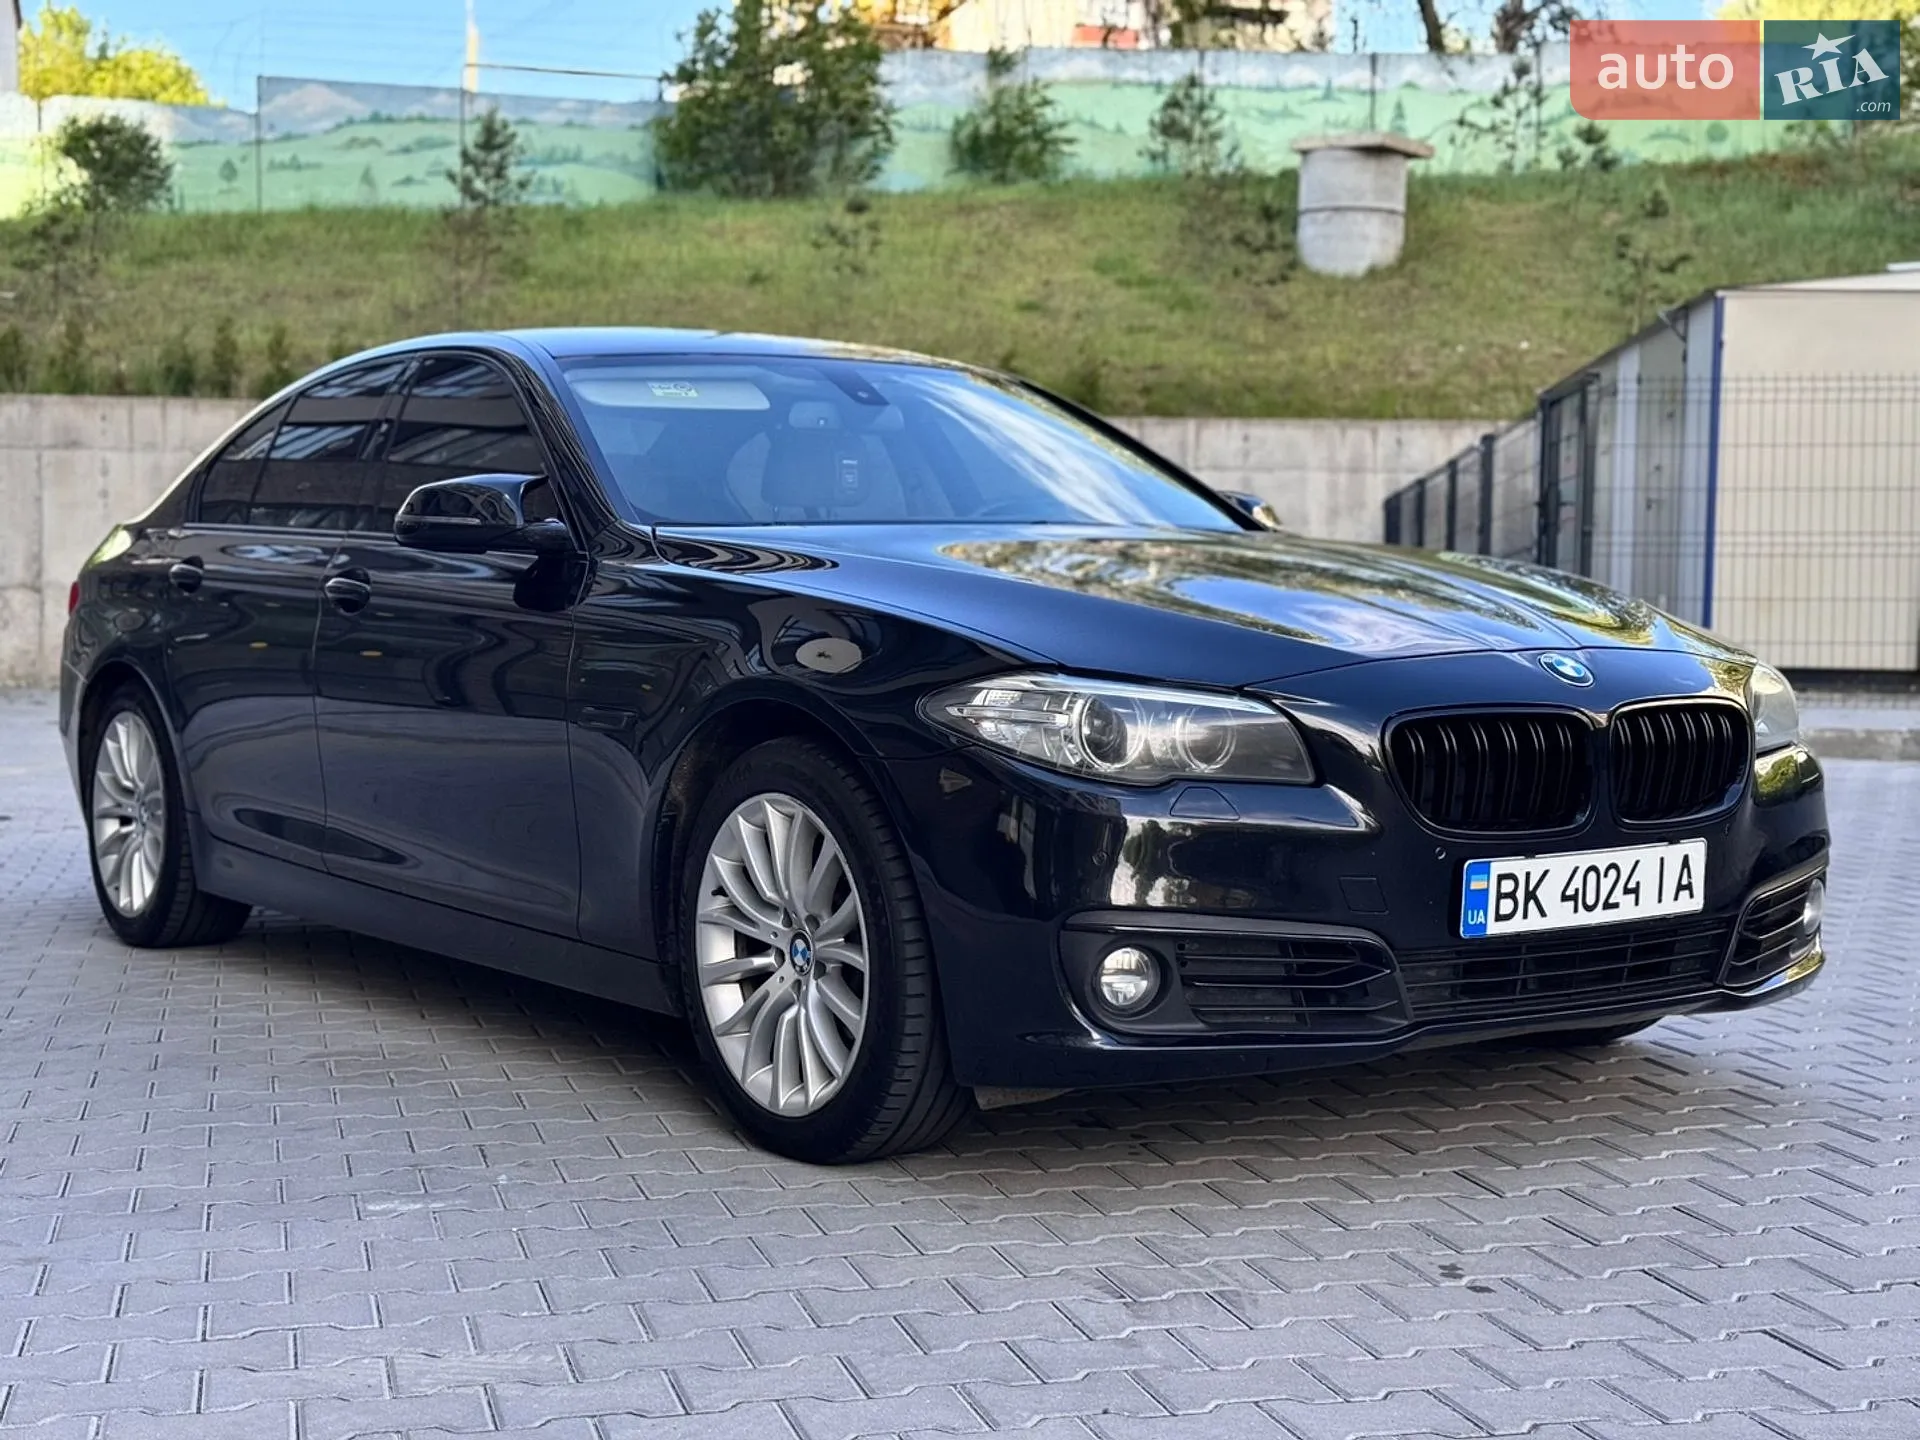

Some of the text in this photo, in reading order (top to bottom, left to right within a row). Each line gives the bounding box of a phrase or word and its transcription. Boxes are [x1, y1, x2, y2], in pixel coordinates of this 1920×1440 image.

[1494, 854, 1694, 922] BK 4024 IA
[1468, 909, 1486, 925] UA
